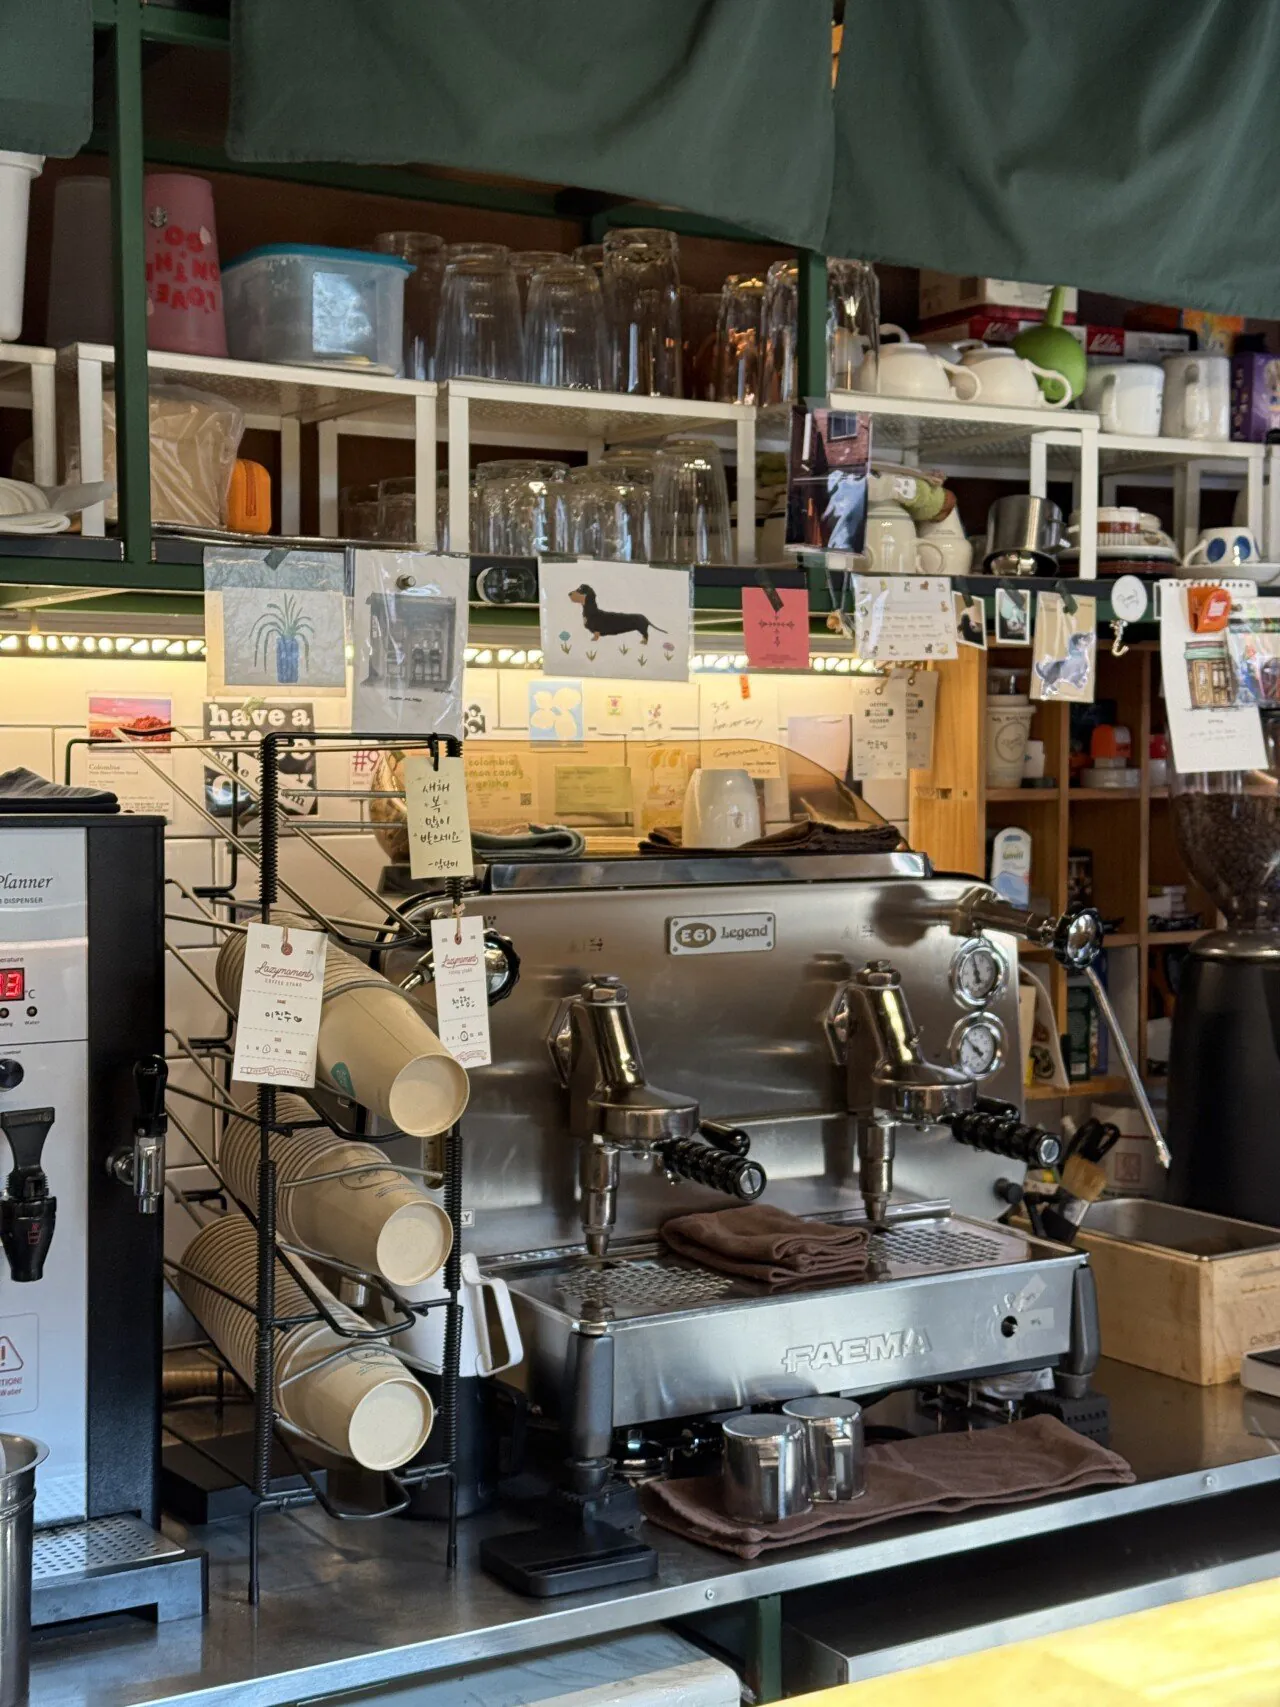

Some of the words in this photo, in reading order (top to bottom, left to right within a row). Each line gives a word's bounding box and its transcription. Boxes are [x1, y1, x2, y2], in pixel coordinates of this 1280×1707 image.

[209, 704, 286, 727] have
[291, 709, 311, 727] a
[352, 749, 380, 772] #9
[4, 896, 43, 905] DISPENSER
[720, 924, 768, 941] Legend
[0, 973, 21, 997] 3
[781, 1328, 933, 1373] FAEMA
